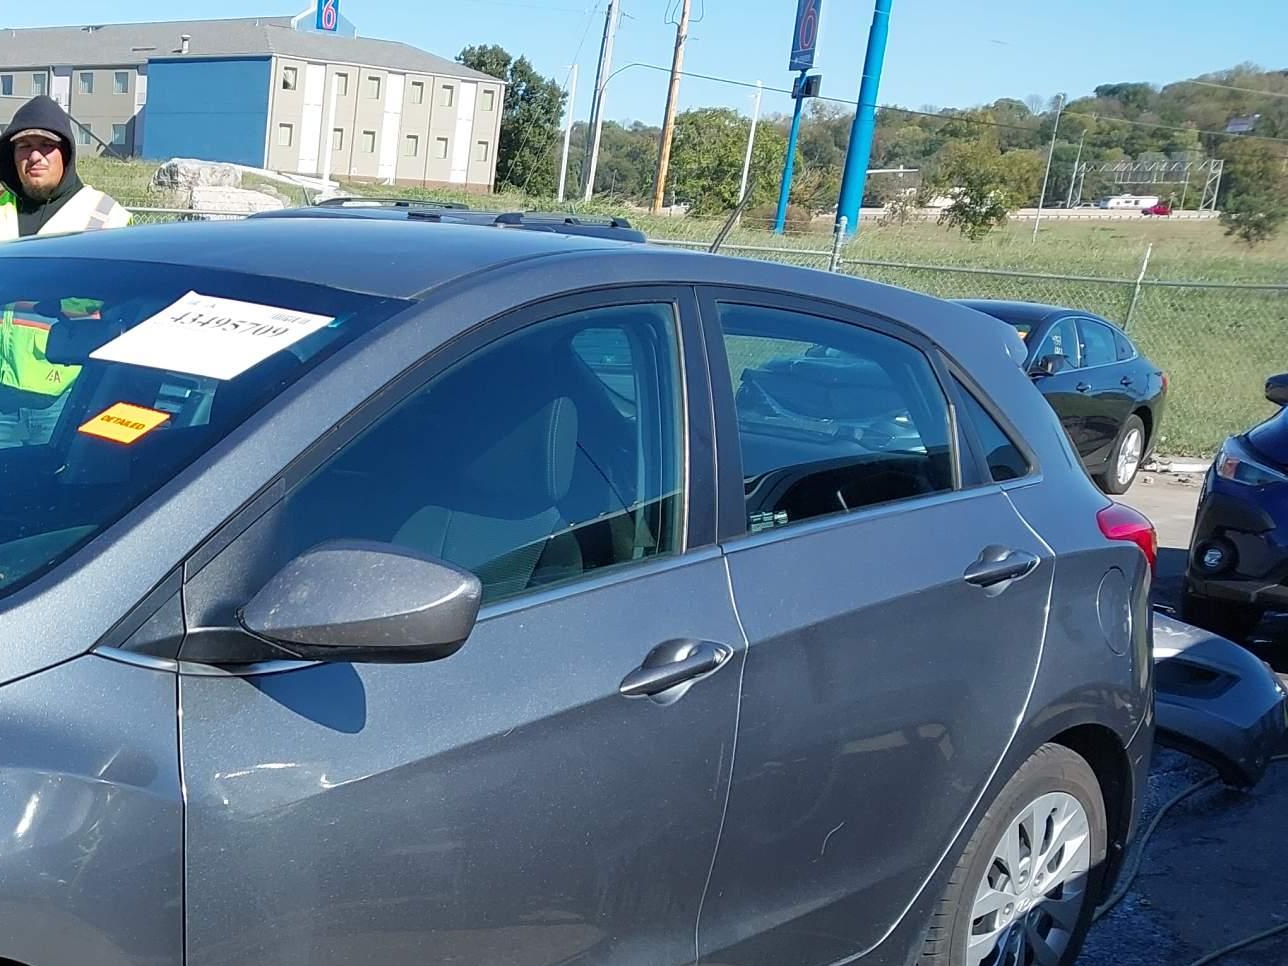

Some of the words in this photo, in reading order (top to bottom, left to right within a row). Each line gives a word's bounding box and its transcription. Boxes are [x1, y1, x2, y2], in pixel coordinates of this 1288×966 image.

[322, 0, 337, 30] 6
[799, 0, 818, 50] 6
[170, 311, 289, 338] 43495709
[100, 414, 146, 430] DETAILED
